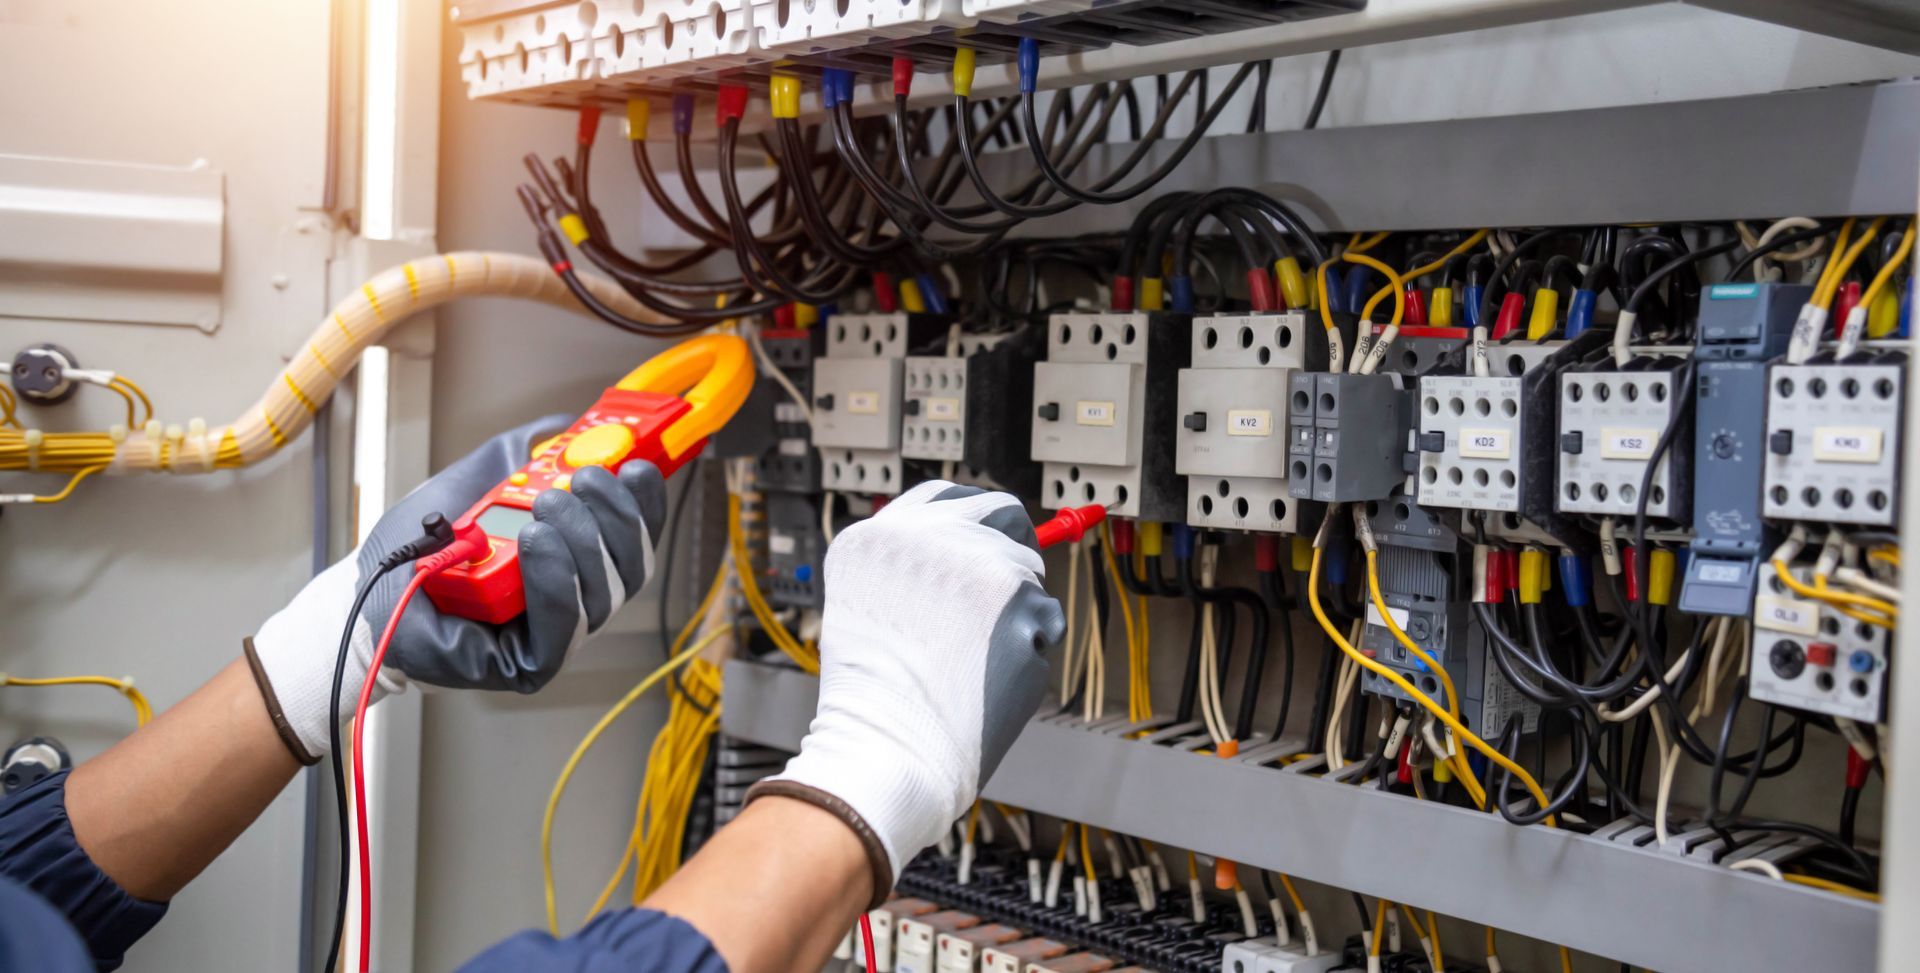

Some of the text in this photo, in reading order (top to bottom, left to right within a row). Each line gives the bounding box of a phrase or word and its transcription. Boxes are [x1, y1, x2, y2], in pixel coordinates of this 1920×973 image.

[1087, 407, 1102, 417] KV1
[1240, 417, 1257, 427] KV2
[1474, 437, 1496, 447] KD2
[1619, 438, 1643, 449] KS2
